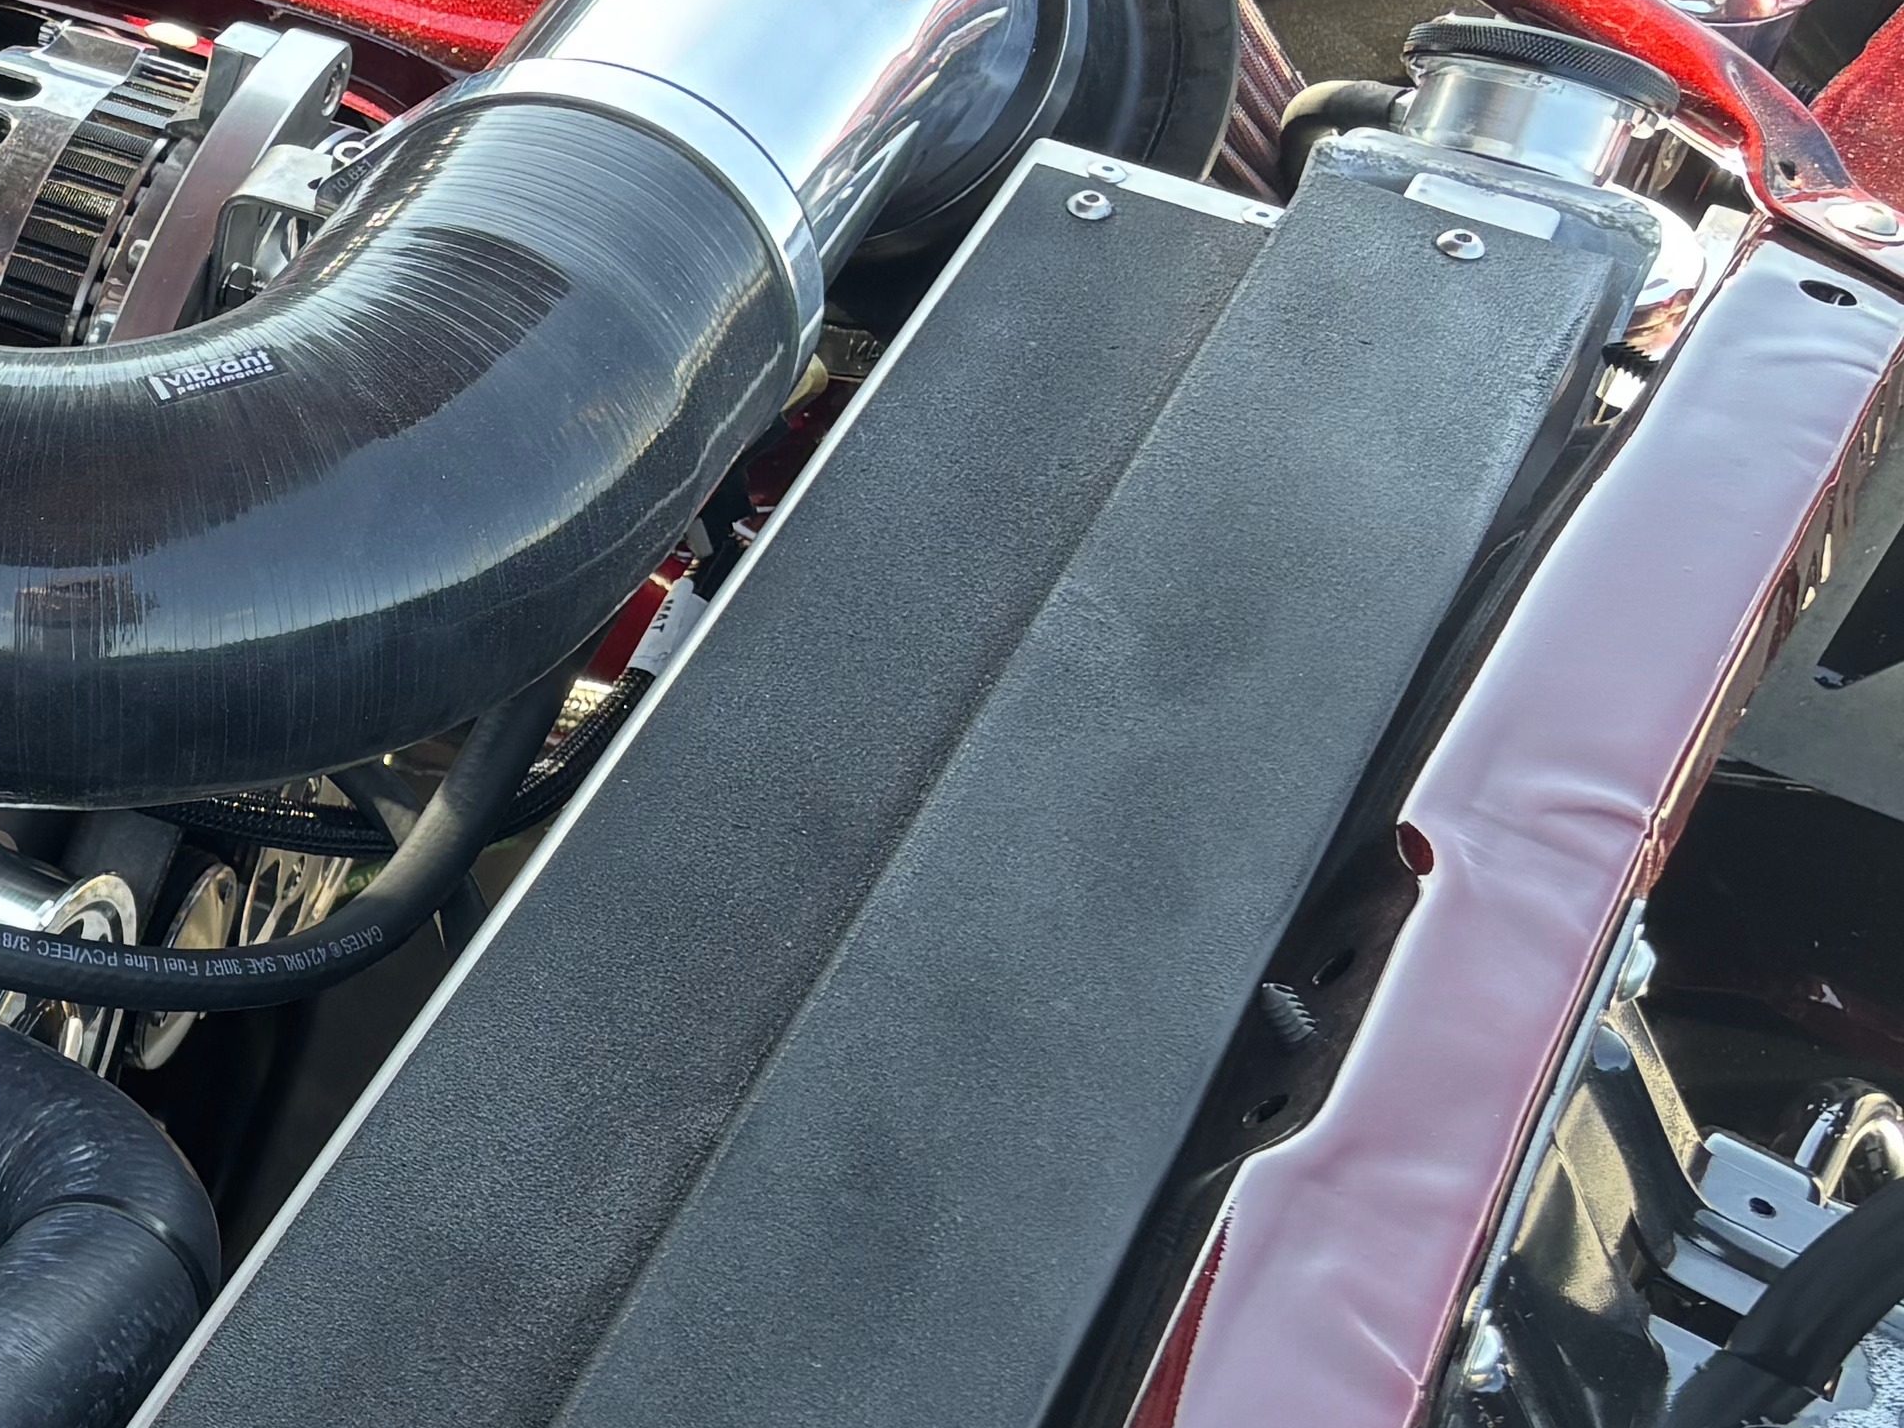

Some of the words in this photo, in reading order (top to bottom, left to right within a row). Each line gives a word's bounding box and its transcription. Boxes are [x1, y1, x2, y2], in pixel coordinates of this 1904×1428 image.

[163, 348, 272, 387] vibrant
[176, 364, 274, 396] performance
[37, 939, 118, 968] PCV/EEC
[124, 952, 160, 974] Line
[163, 959, 199, 977] Fuel
[204, 959, 242, 977] 30R7
[245, 956, 277, 975] SAE
